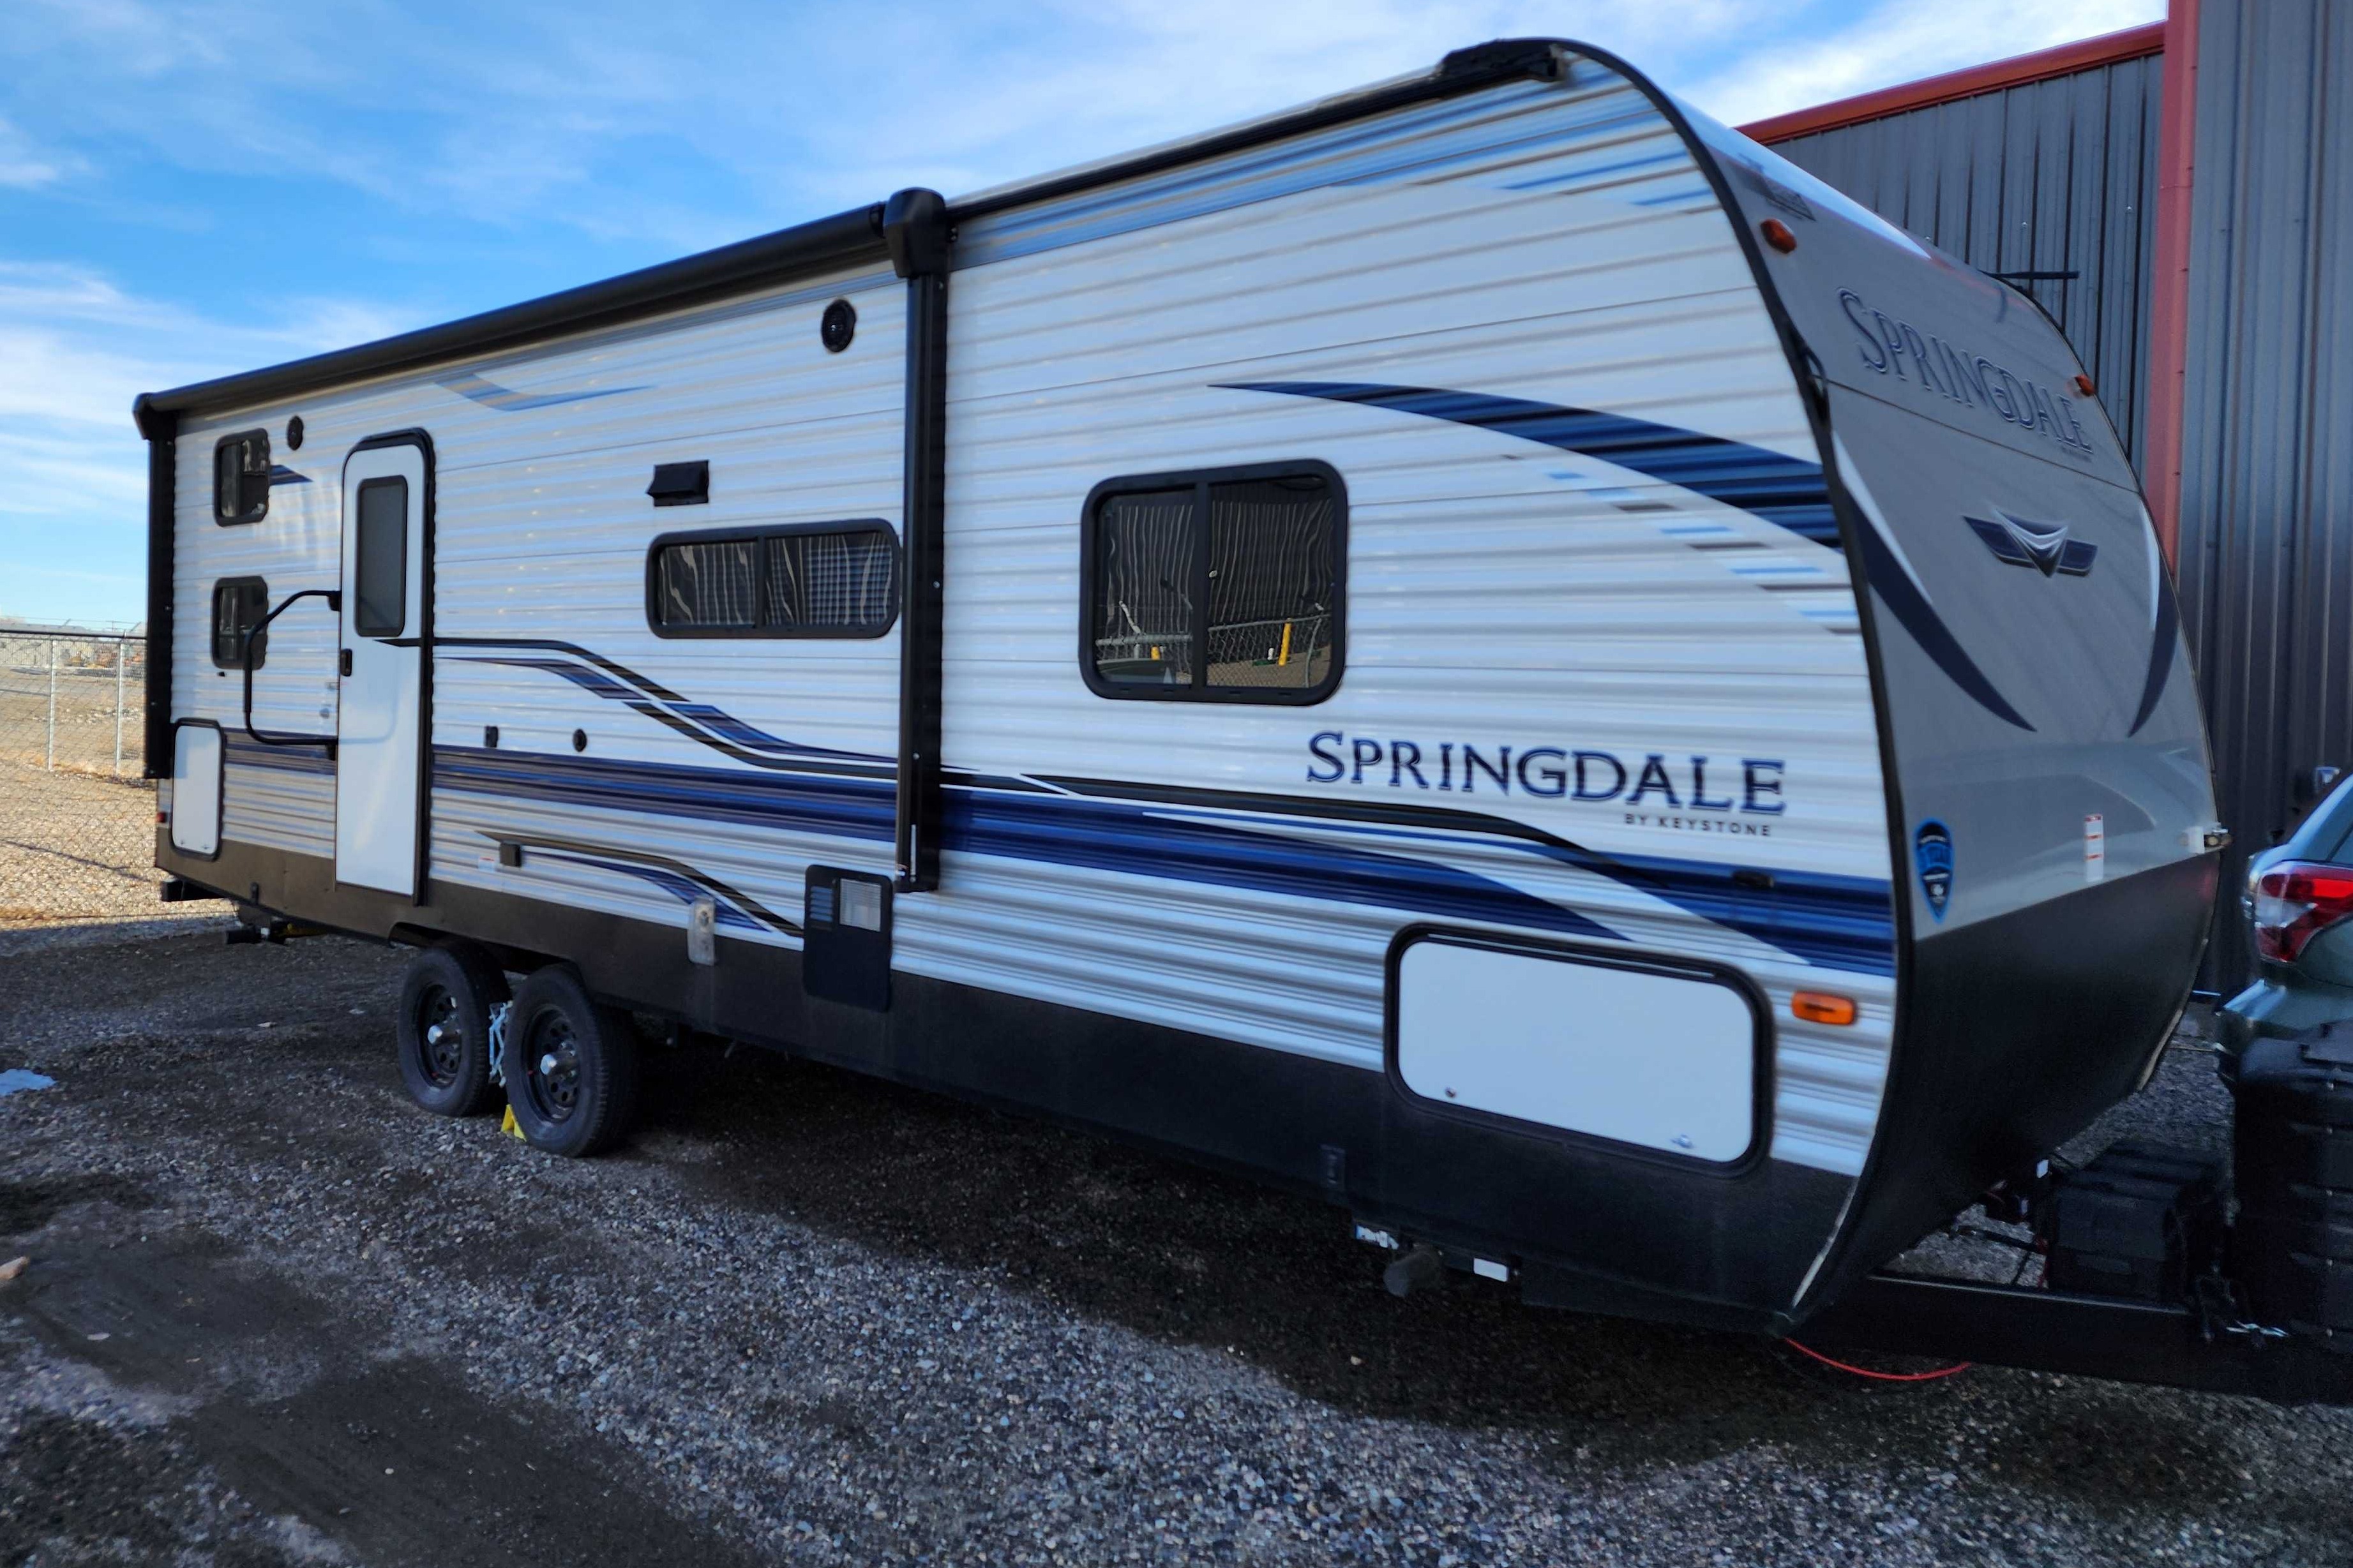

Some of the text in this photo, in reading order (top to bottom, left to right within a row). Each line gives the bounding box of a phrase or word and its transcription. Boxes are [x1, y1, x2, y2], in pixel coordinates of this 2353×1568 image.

[1838, 287, 2093, 455] SPRINGDALE
[1306, 730, 1787, 816] SPRINGDALE
[1625, 814, 1771, 837] BY KEYSTONE
